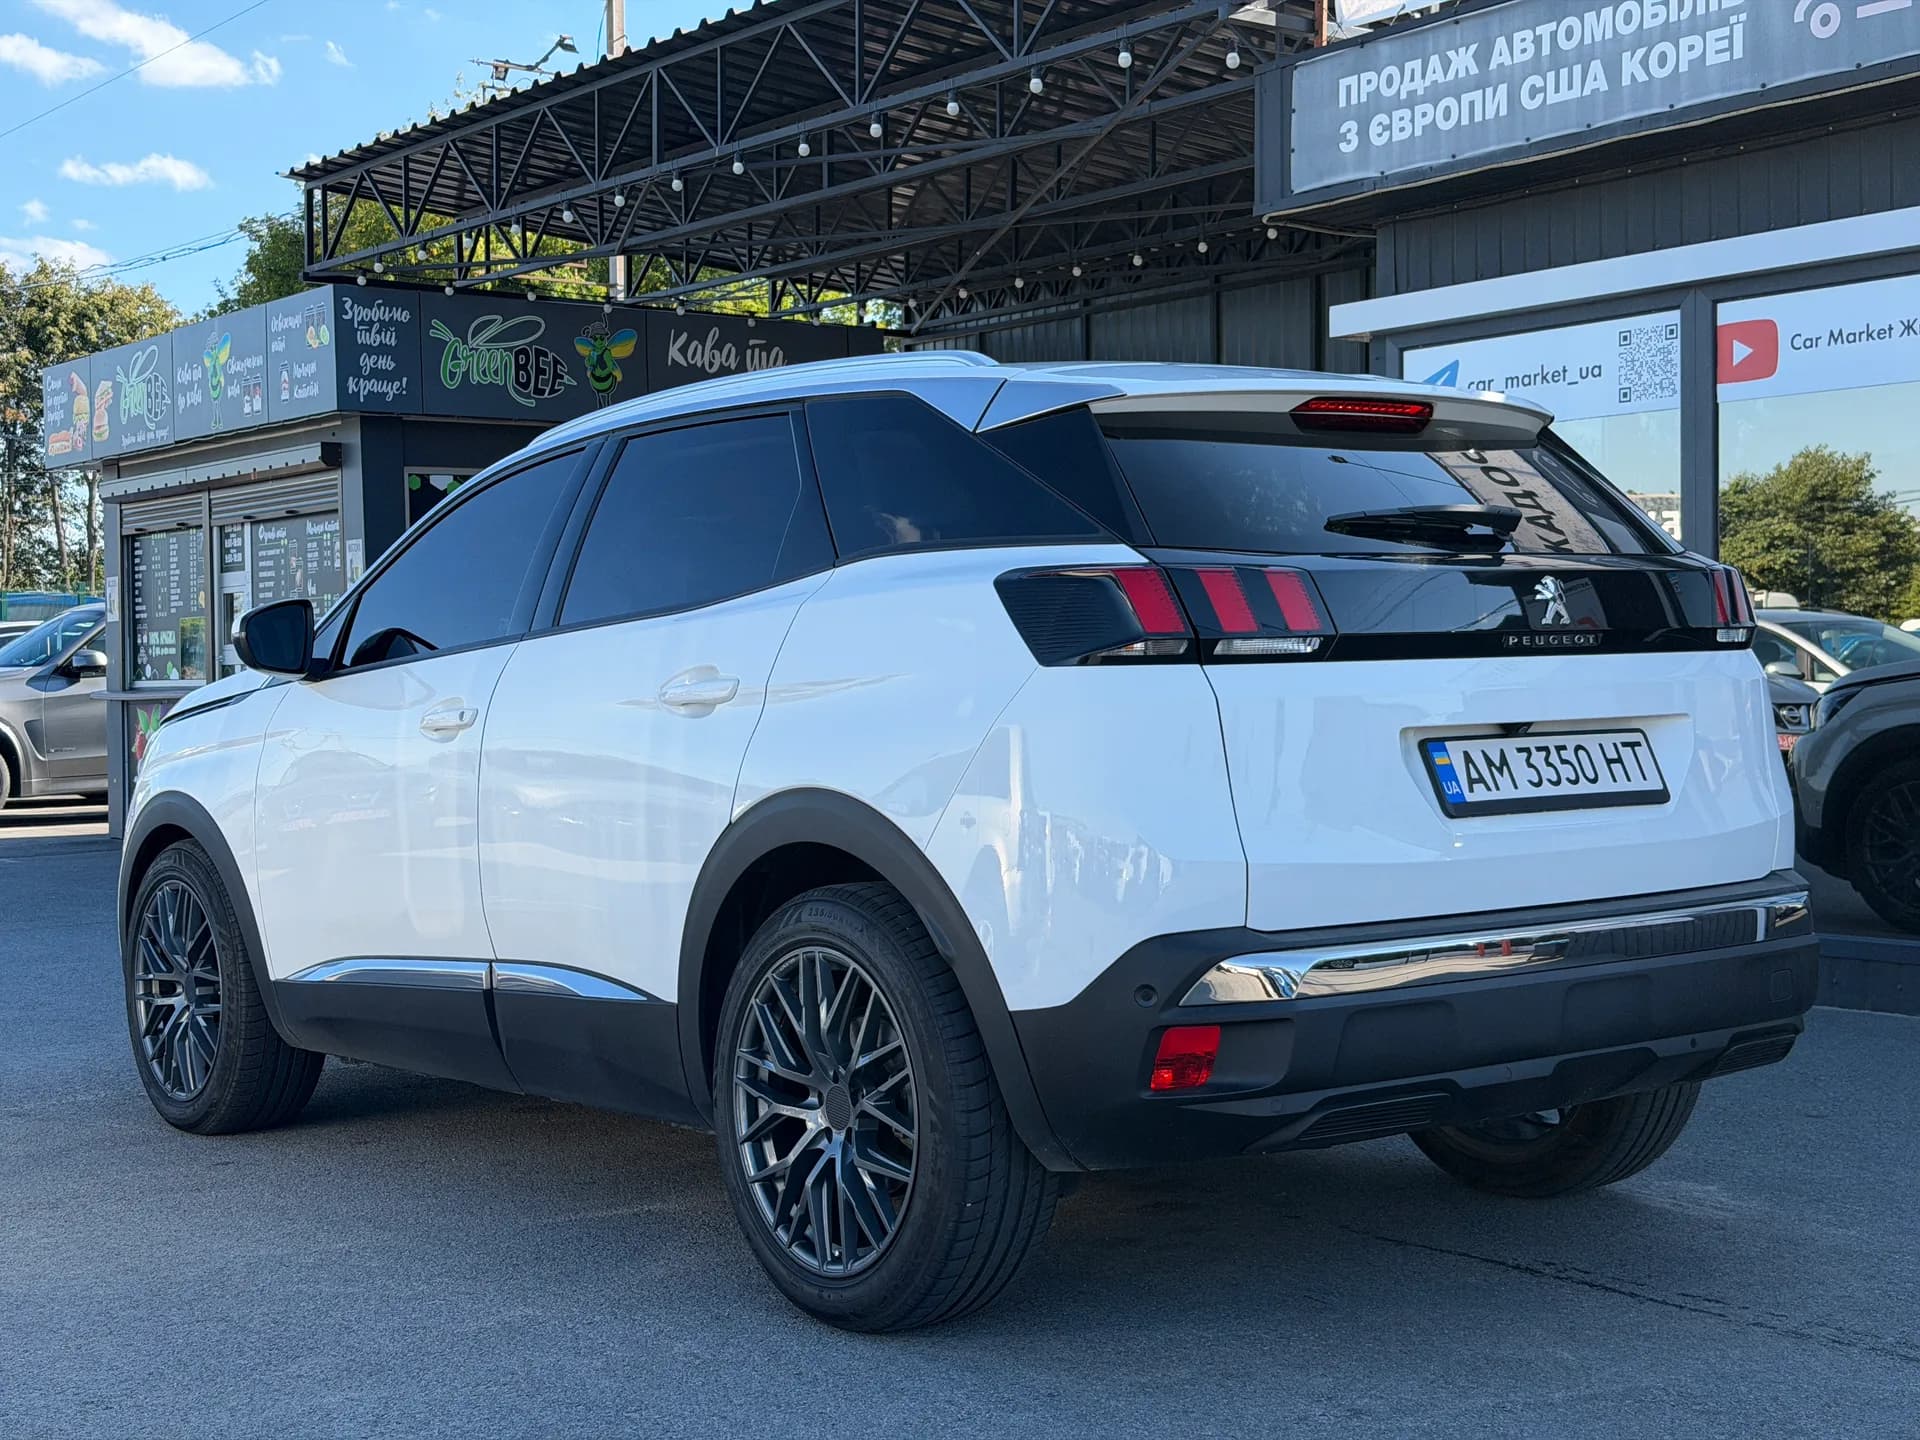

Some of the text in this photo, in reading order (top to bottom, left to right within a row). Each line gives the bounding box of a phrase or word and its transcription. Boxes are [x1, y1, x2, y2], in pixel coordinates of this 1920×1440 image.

[1339, 0, 1746, 108] ПРОДАЖ АВТОМОБІЛ
[1338, 13, 1747, 153] З ЄВРОПИ США КОРЕЇ
[341, 297, 411, 329] Зробимо
[357, 322, 398, 347] твій
[1790, 317, 1920, 351] Car Market Ж
[360, 352, 396, 376] день
[667, 326, 788, 374] Кава та
[346, 376, 408, 403] краще!
[1467, 362, 1602, 393] car_market_ua
[1508, 633, 1597, 647] PEUGEOT
[1516, 743, 1600, 789] 3350
[1443, 779, 1462, 795] UA
